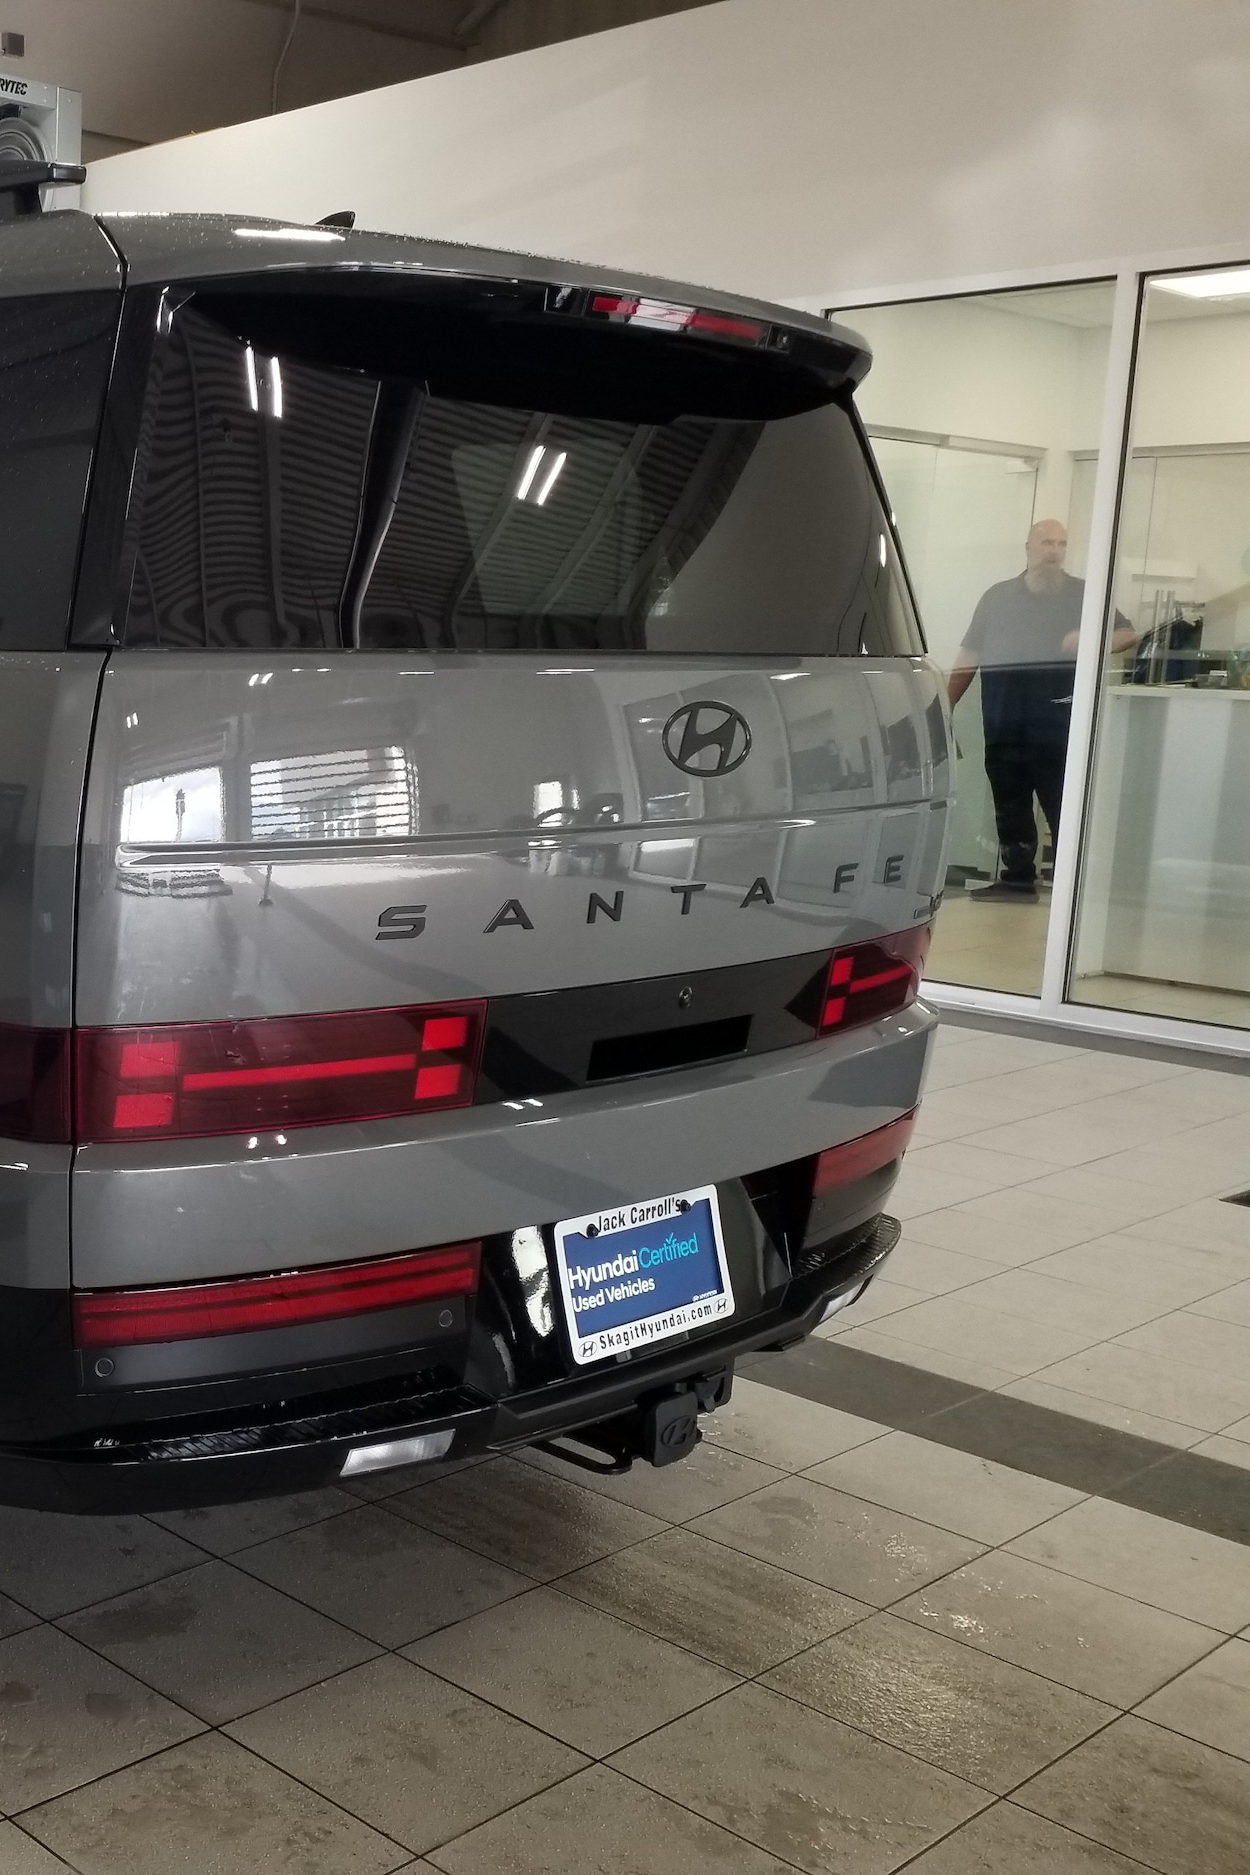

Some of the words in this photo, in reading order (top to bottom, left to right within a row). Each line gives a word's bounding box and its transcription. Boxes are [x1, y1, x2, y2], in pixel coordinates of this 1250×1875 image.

[375, 877, 776, 941] SANTA
[832, 855, 905, 894] FE
[597, 1211, 626, 1232] Jack
[630, 1197, 681, 1225] Carroll's
[567, 1249, 639, 1291] Hyundai
[638, 1232, 699, 1269] Certified
[572, 1288, 606, 1313] Used
[605, 1277, 656, 1303] Vehicles
[598, 1304, 713, 1350] SkagitHyundai.com
